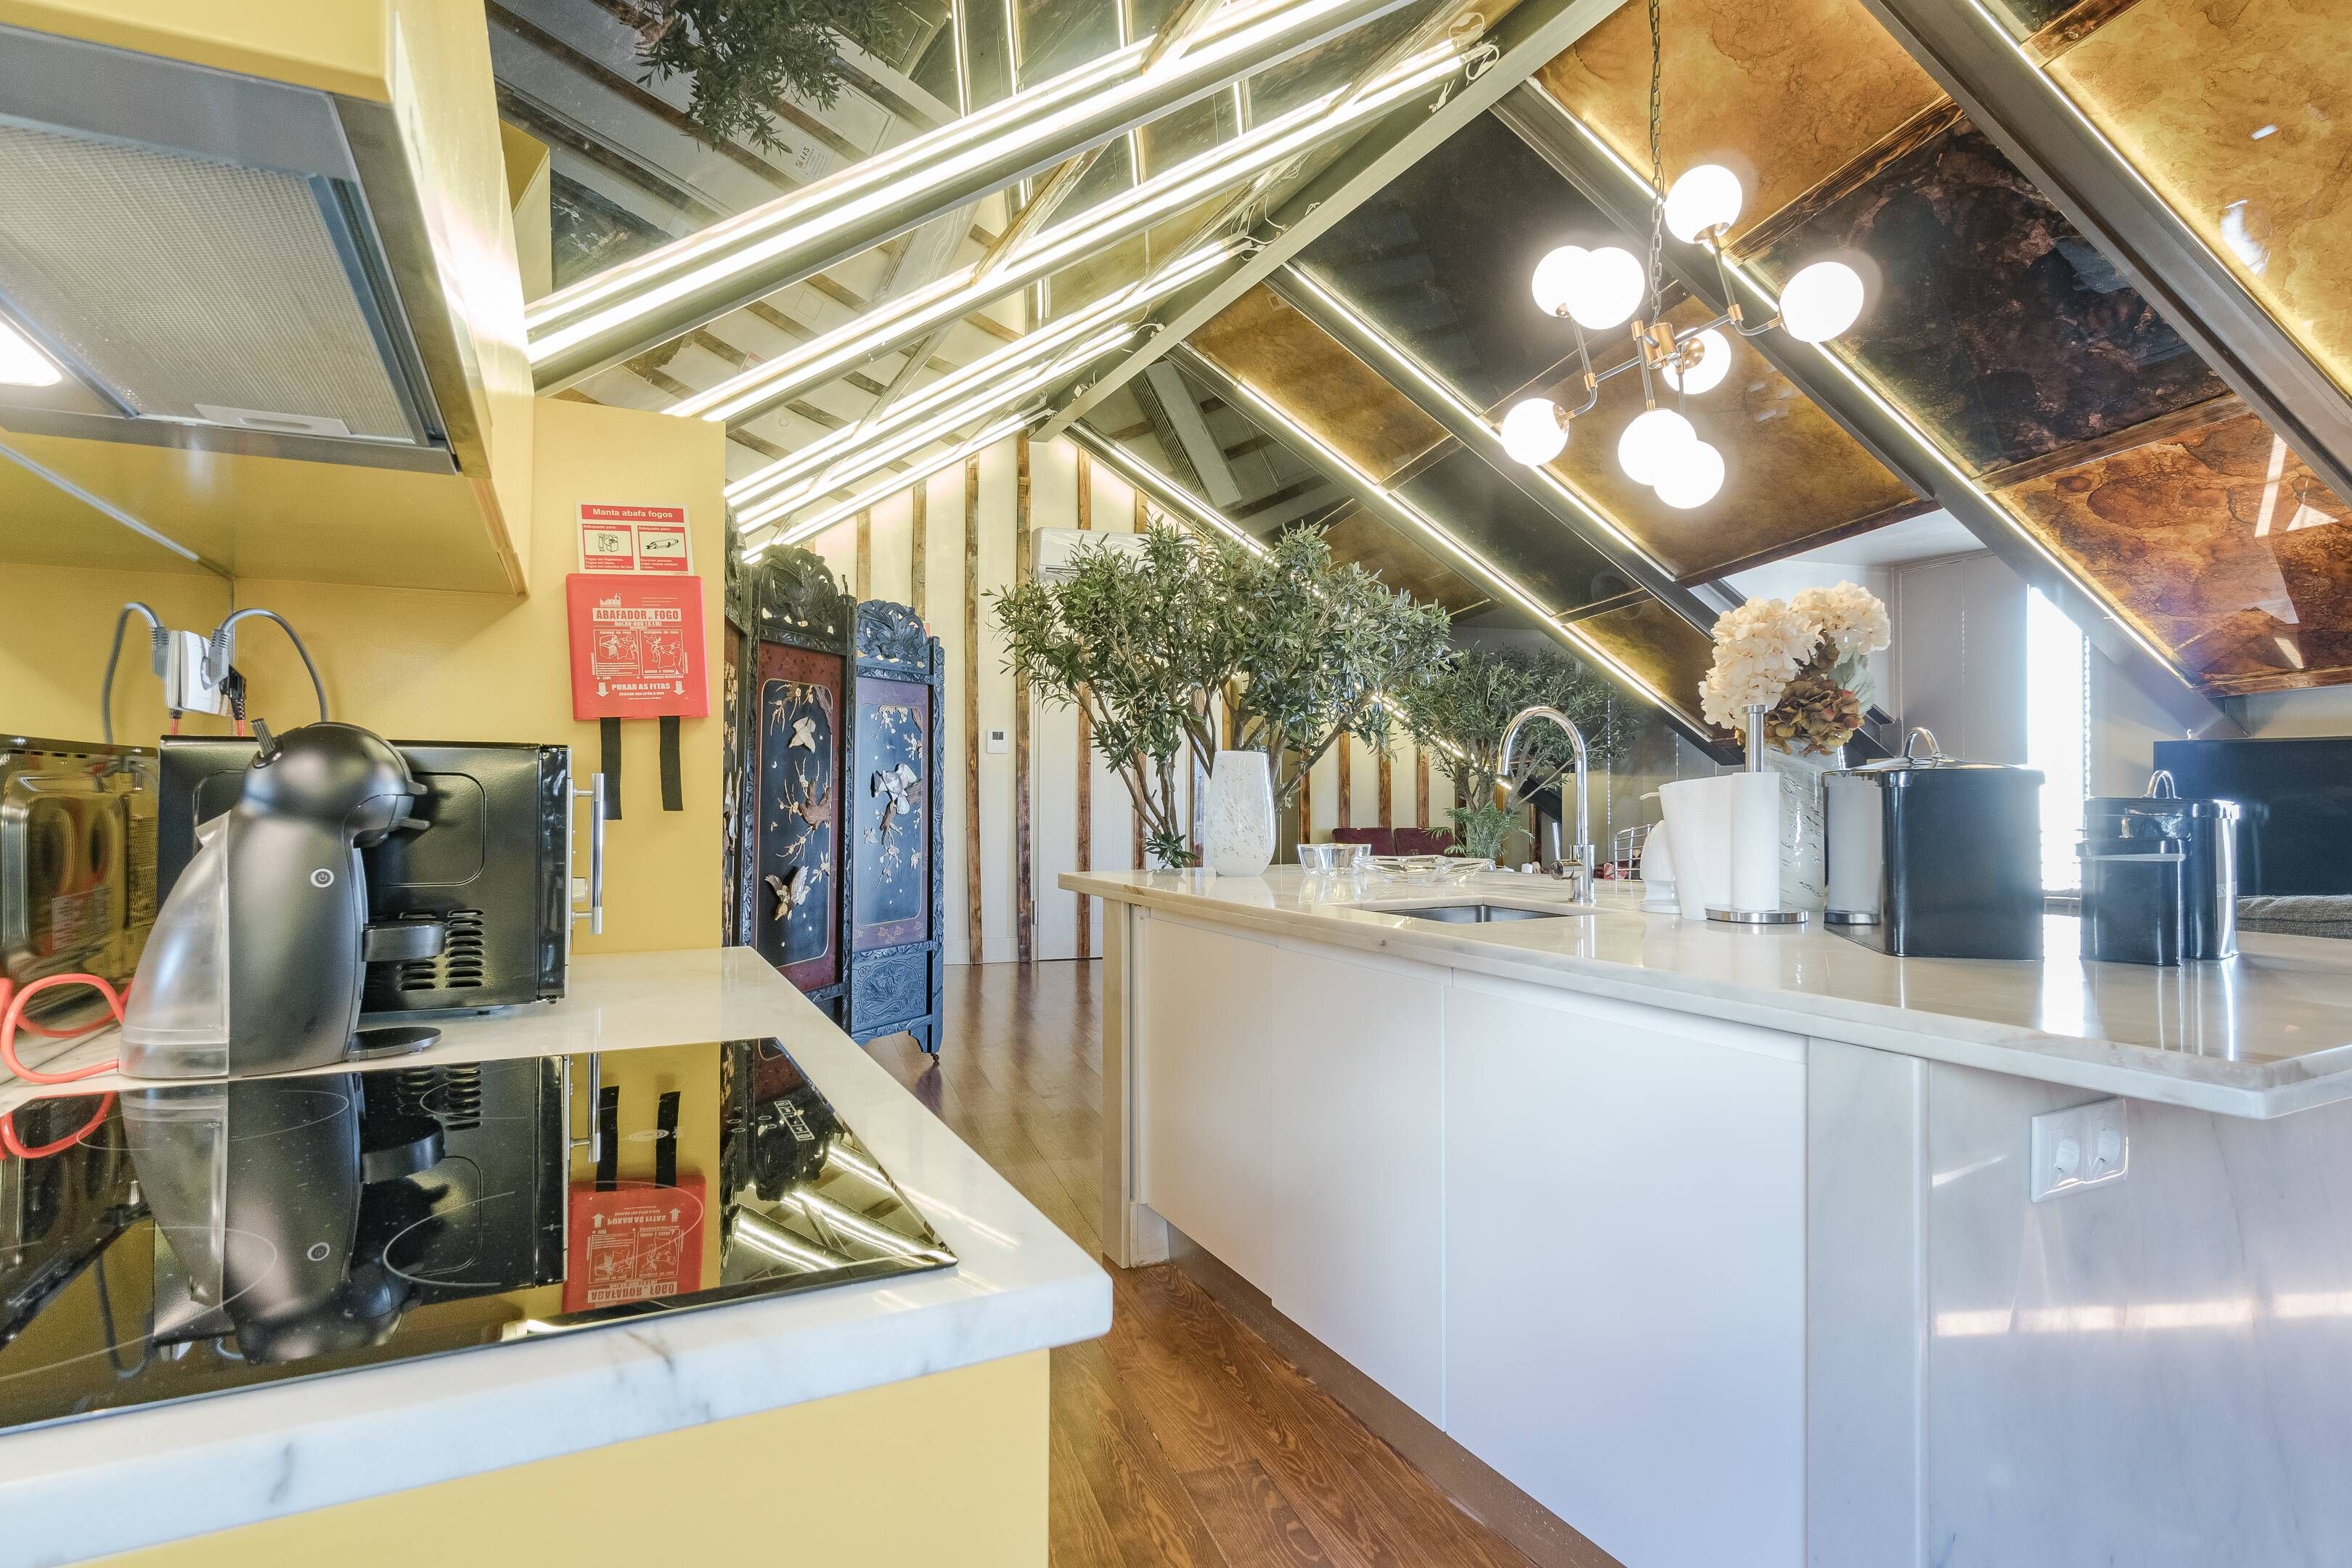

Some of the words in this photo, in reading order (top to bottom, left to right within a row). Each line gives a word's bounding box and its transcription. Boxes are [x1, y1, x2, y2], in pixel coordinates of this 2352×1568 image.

[648, 510, 673, 519] fogos
[596, 610, 647, 619] ABAFADOR
[654, 610, 679, 619] FOGO
